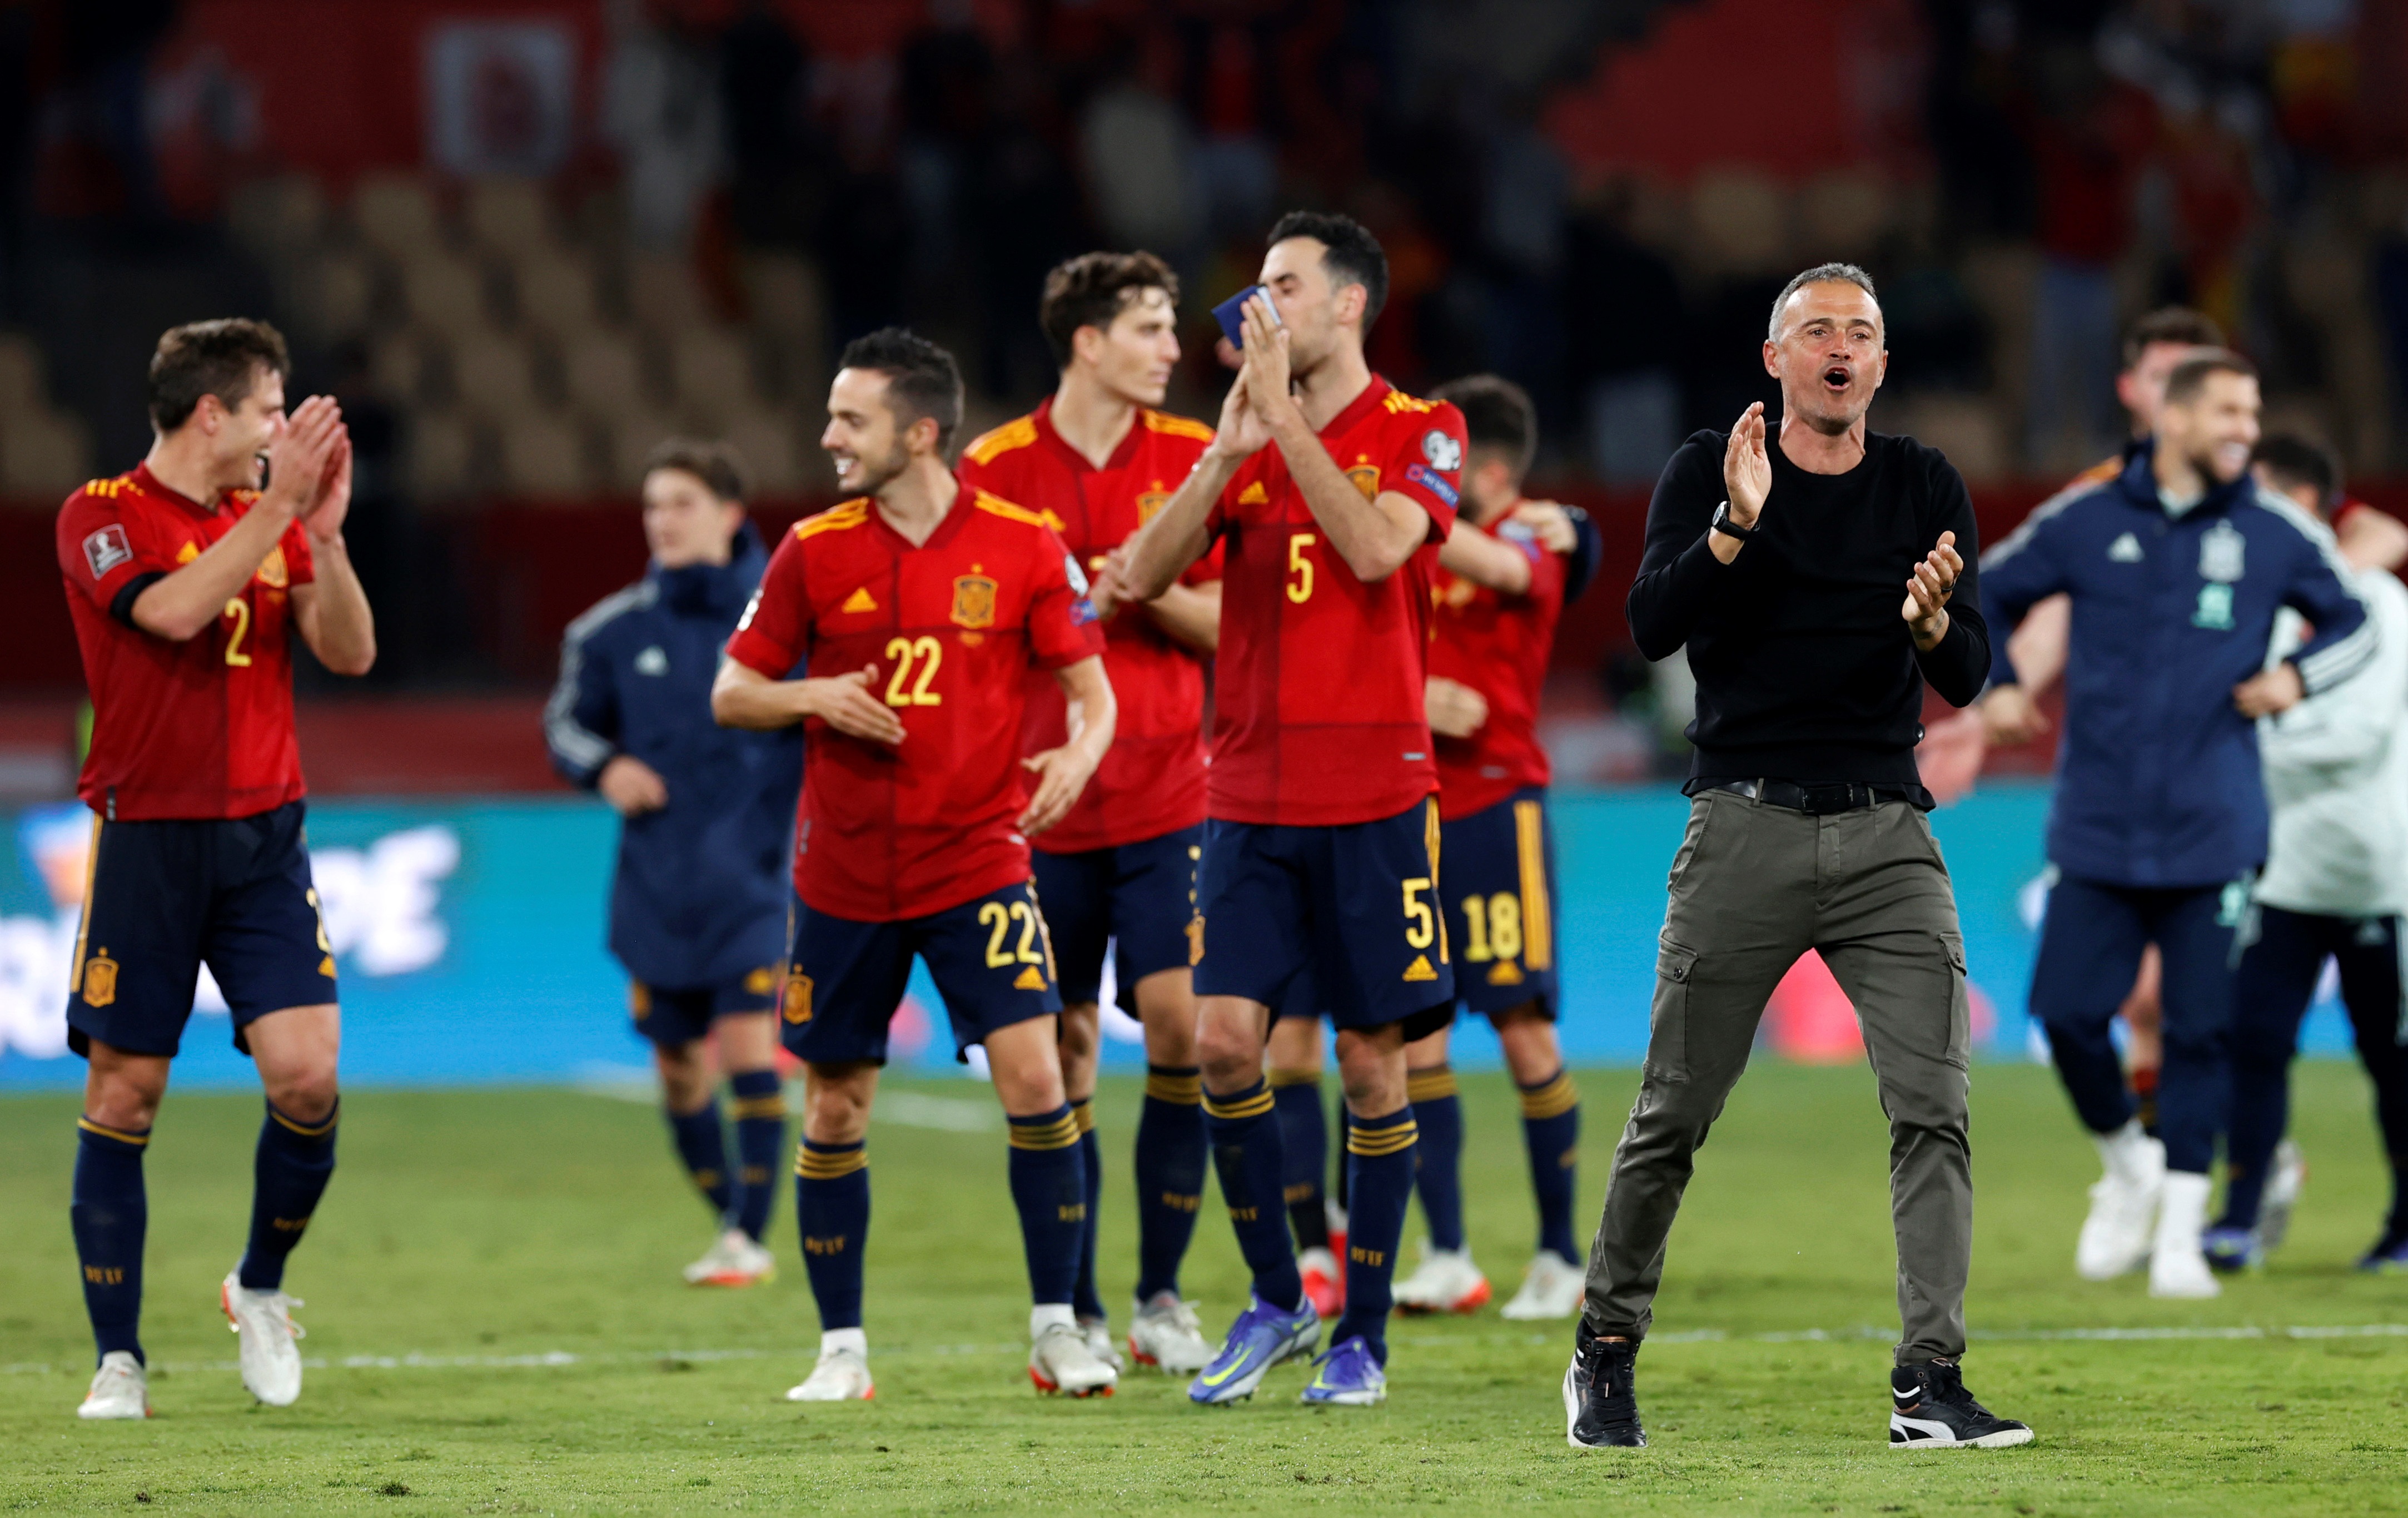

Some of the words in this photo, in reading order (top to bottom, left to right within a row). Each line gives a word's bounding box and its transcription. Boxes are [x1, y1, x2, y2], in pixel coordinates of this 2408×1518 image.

[1286, 533, 1316, 604] 5
[224, 597, 252, 667] 2
[884, 636, 943, 707] 22
[978, 900, 1044, 969] 22
[1401, 877, 1435, 949] 5
[1461, 891, 1523, 963] 18
